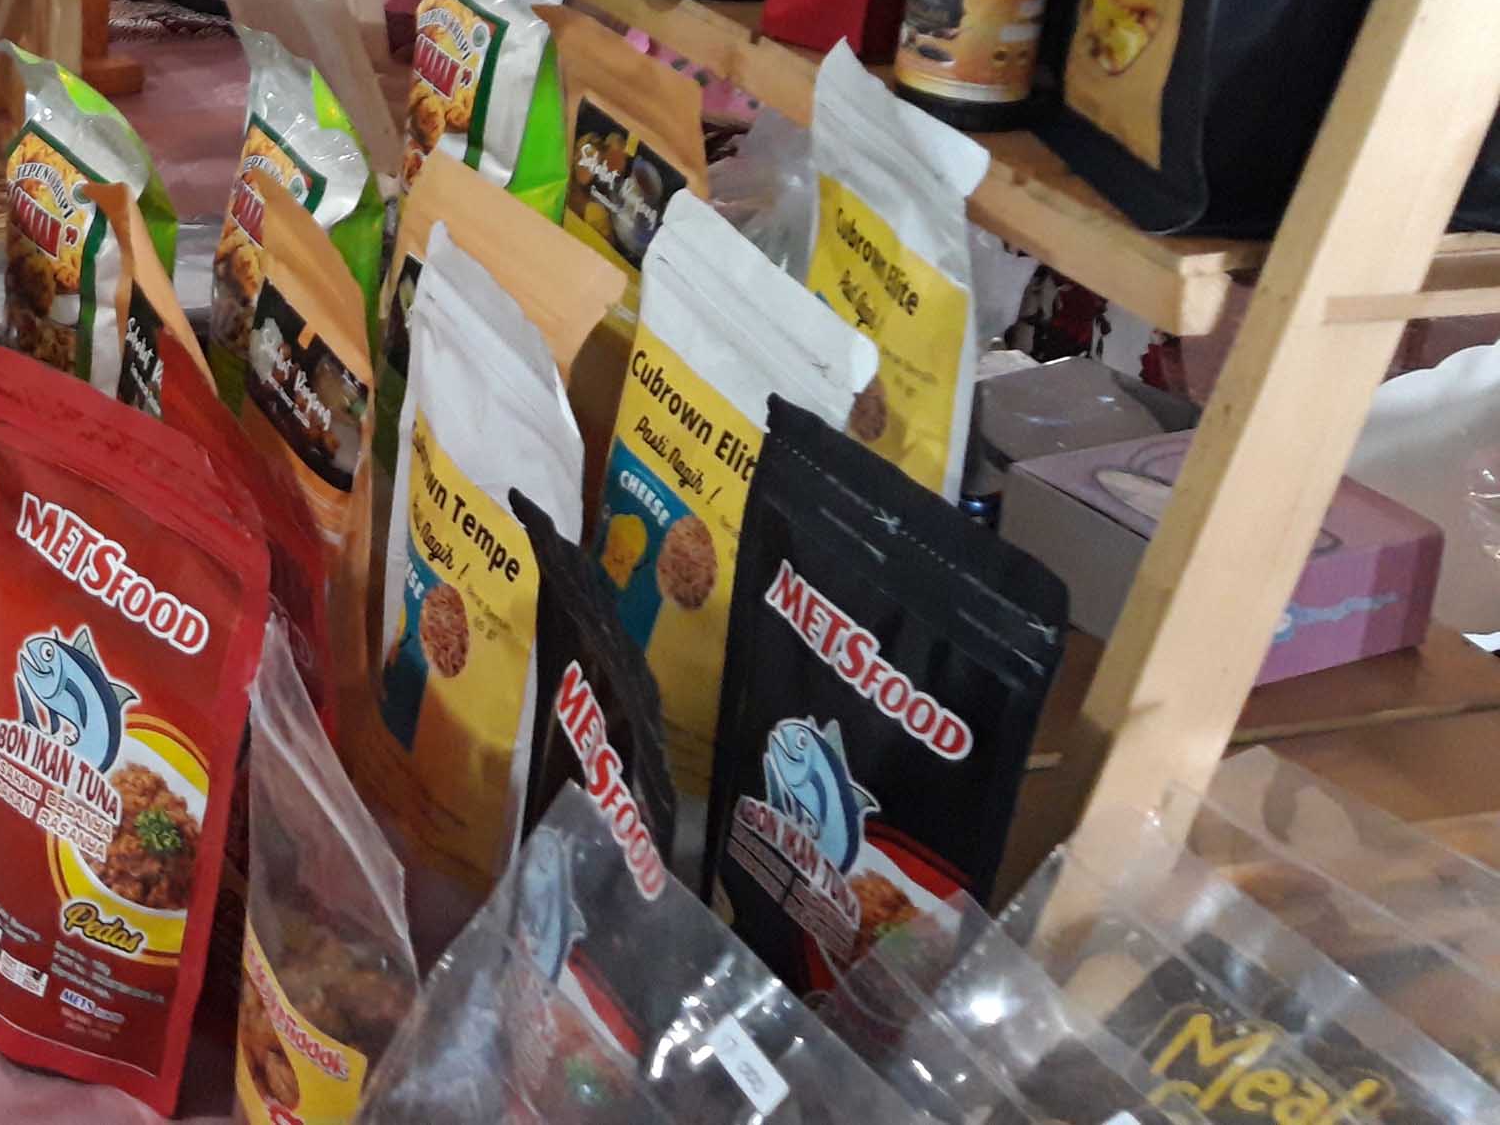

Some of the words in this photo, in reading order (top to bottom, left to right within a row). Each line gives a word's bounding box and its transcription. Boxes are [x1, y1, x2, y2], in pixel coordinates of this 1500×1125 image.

[631, 349, 714, 446] Cubrown
[713, 430, 758, 483] Elit
[635, 415, 669, 459] Pasti
[449, 493, 522, 583] Tempe
[619, 469, 672, 528] CHEESE
[16, 491, 210, 655] METSFOOD
[764, 558, 974, 761] METSFOOD
[31, 733, 76, 788] IKAN
[76, 759, 121, 822] TUNA
[63, 901, 145, 954] Pedas
